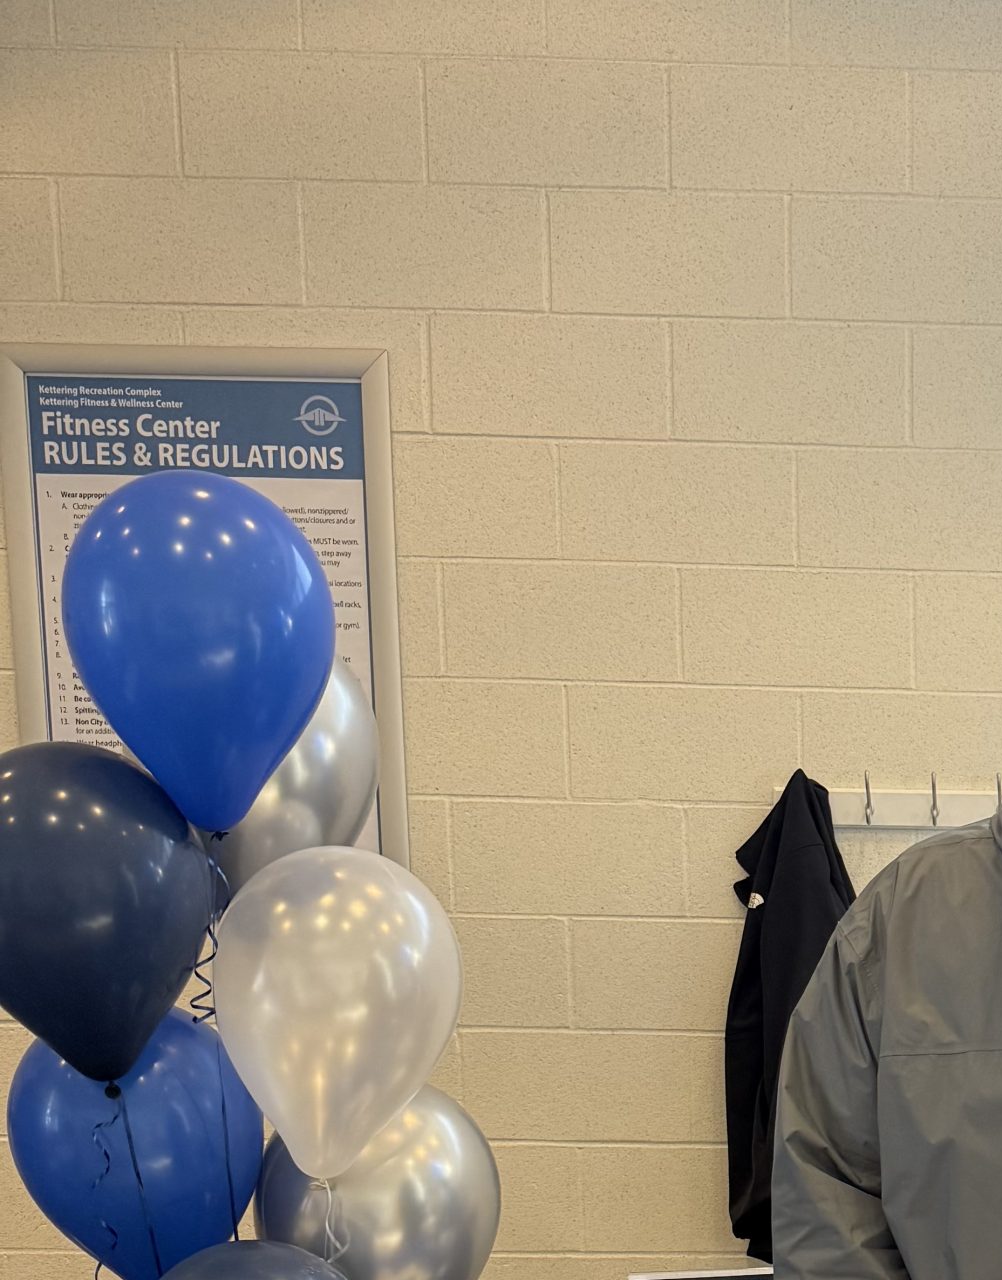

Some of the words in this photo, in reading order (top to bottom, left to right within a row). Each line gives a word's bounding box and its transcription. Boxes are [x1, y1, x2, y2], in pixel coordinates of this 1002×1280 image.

[39, 385, 78, 396] Kettering
[79, 386, 123, 396] Recreation
[125, 386, 162, 398] Complex
[40, 397, 78, 408] Kettering
[80, 398, 109, 407] Fitness
[111, 398, 118, 407] &
[119, 398, 154, 408] Wellness
[156, 399, 183, 409] Center
[41, 411, 130, 437] Fitness
[136, 414, 220, 438] Center
[44, 441, 127, 465] RULES
[133, 442, 152, 466] &
[158, 444, 344, 471] REGULATIONS
[79, 491, 108, 499] appropri
